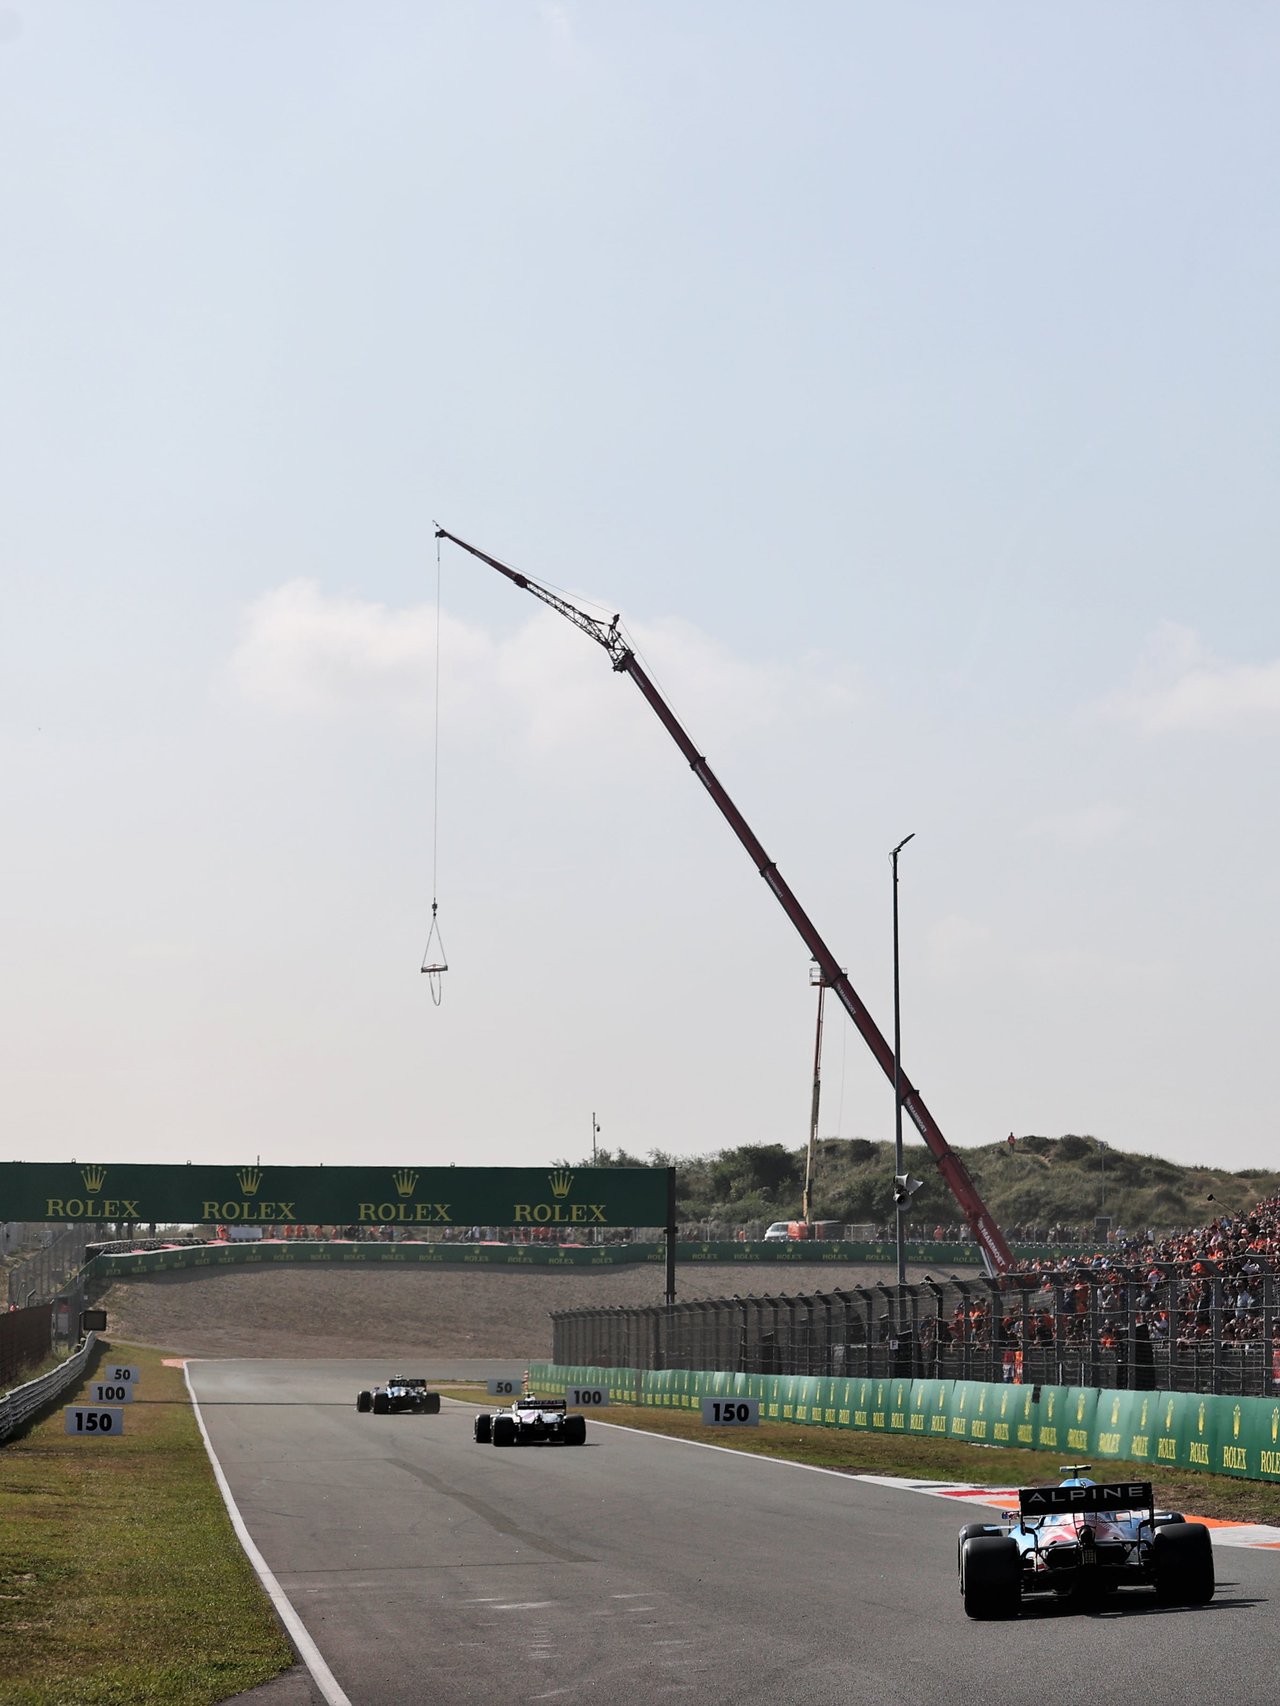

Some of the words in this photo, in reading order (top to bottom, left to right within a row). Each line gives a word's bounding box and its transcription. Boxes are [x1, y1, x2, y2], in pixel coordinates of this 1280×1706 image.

[46, 1199, 140, 1218] ROLEX
[202, 1201, 296, 1220] ROLEX
[358, 1203, 452, 1222] ROLEX
[514, 1204, 607, 1222] ROLEX
[114, 1369, 131, 1381] 50
[97, 1386, 126, 1401] 100
[496, 1382, 513, 1394] 50
[573, 1390, 602, 1405] 100
[712, 1403, 750, 1422] 150
[75, 1412, 113, 1432] 150
[1223, 1446, 1247, 1470] ROLEX
[1028, 1486, 1144, 1503] ALPINE
